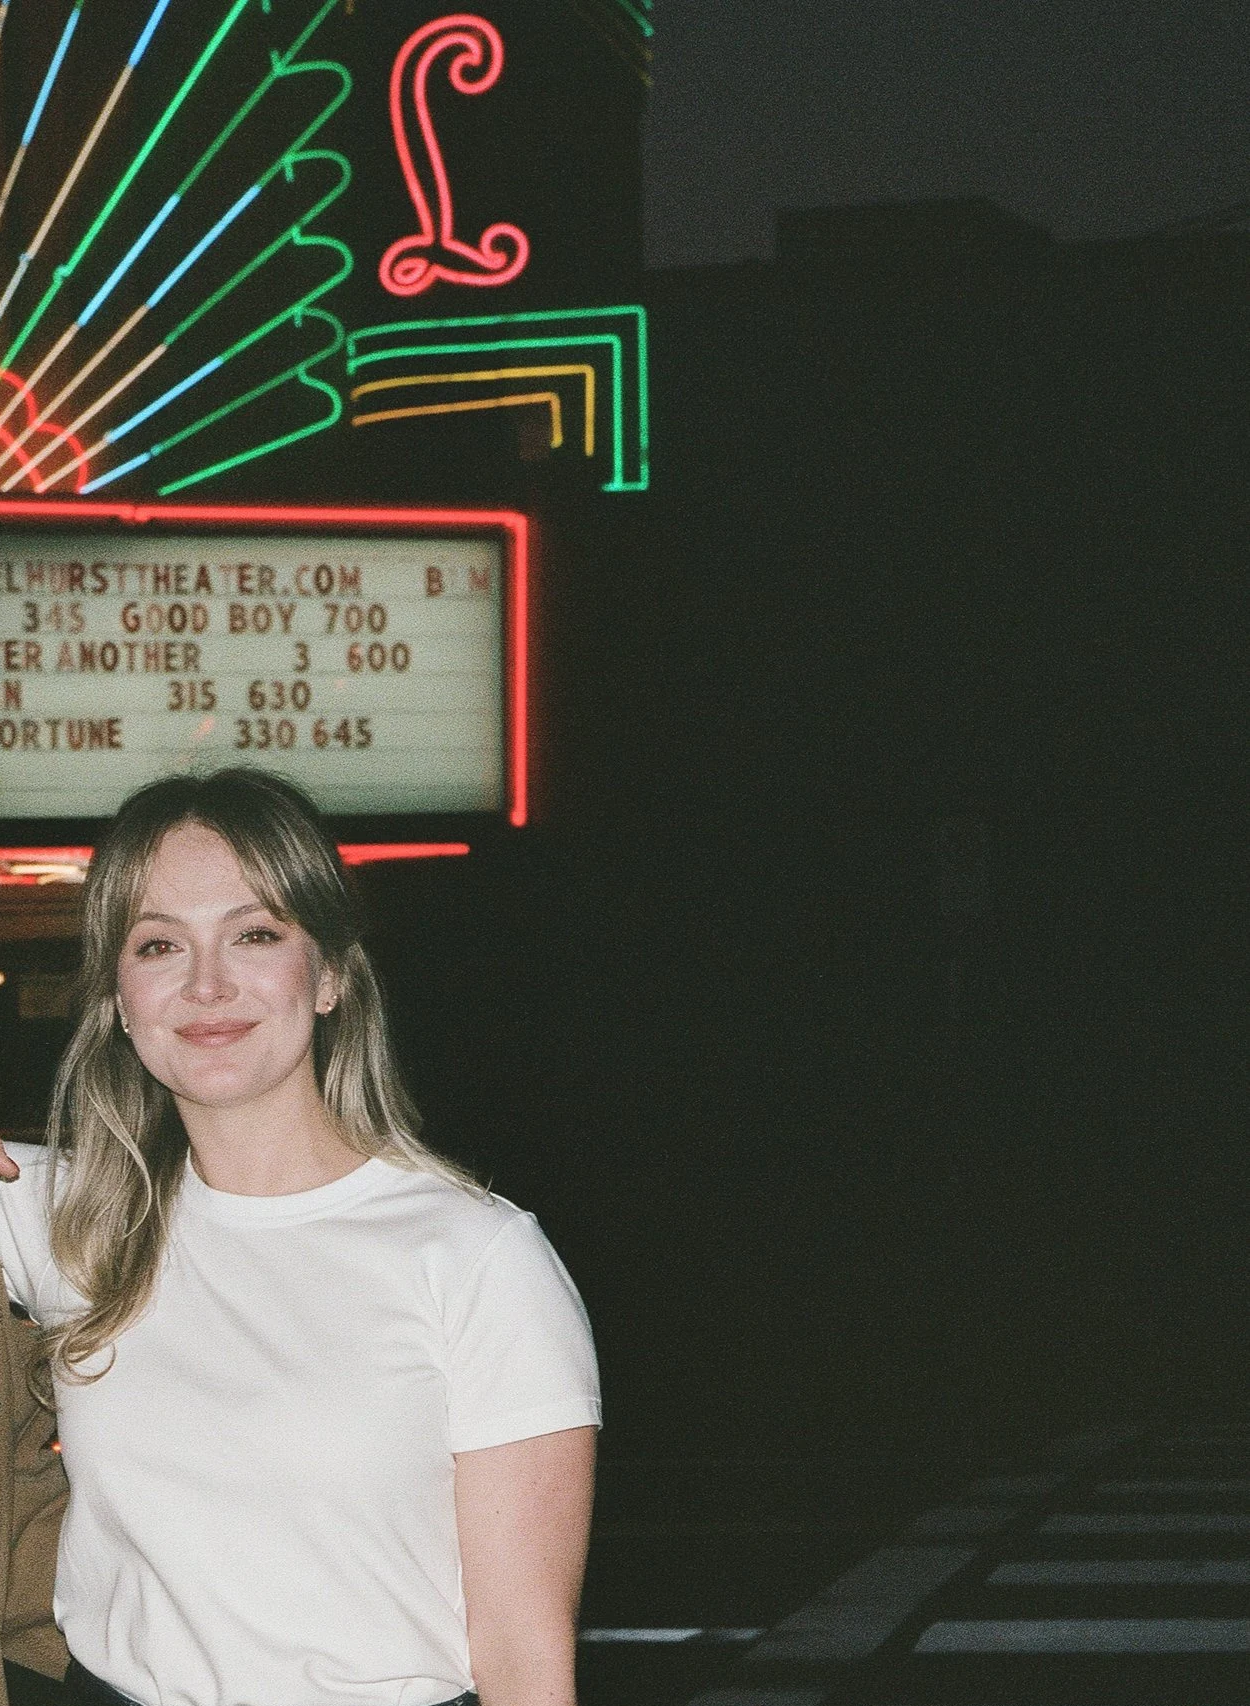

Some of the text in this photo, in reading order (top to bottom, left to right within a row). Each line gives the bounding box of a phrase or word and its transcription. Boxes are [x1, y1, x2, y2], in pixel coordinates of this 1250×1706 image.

[22, 602, 85, 636] 345
[120, 603, 211, 634] GOOD
[228, 603, 296, 635] BOY
[324, 603, 387, 636] 700
[54, 642, 202, 675] ANOTHER
[291, 642, 311, 672] 3
[346, 642, 410, 674] 600
[166, 680, 217, 712] 315
[248, 680, 311, 712] 630
[234, 719, 297, 750] 330
[310, 718, 374, 750] 645
